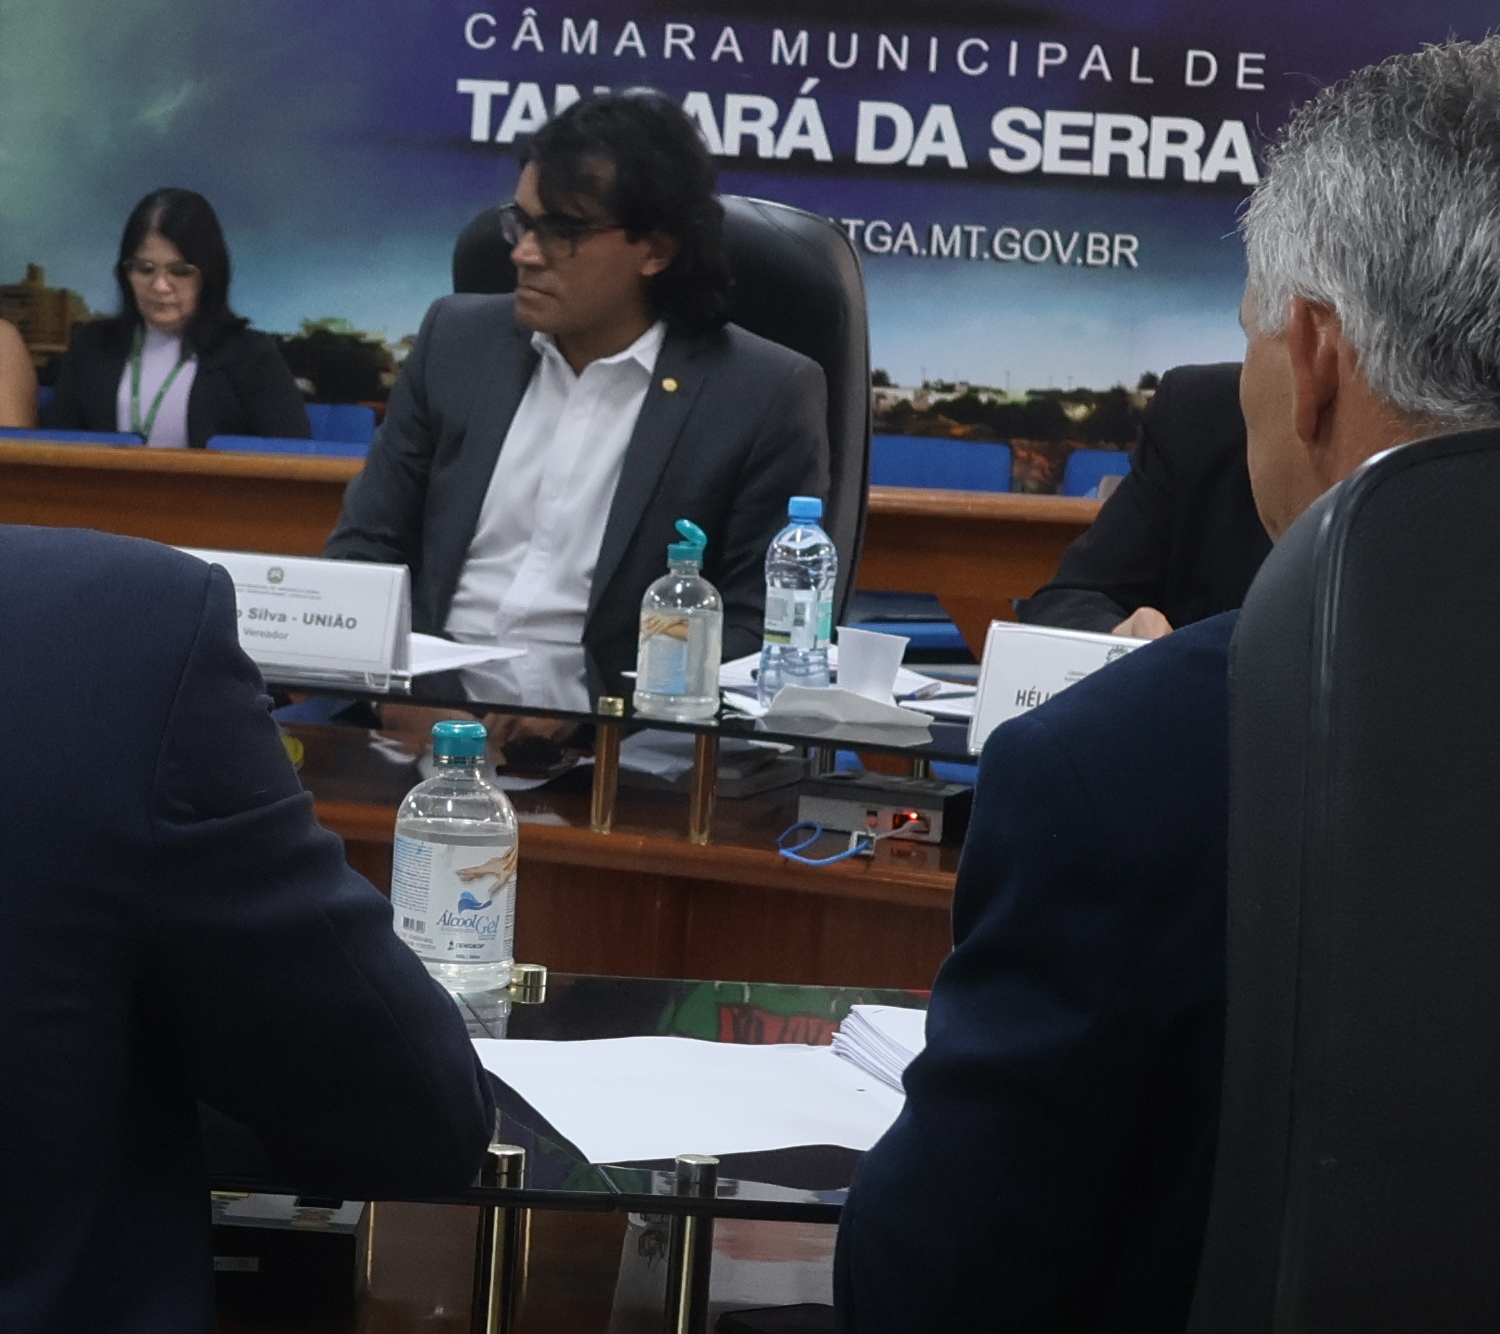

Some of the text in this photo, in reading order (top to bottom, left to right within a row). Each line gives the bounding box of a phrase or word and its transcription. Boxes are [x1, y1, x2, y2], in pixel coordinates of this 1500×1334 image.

[464, 6, 1267, 91] CÂMARA MUNICIPAL DE
[456, 77, 1260, 186] TAARÁ DA SERRA
[830, 216, 1139, 268] TGA.MT.GOV.BR
[243, 626, 290, 640] Vereador
[247, 607, 288, 623] Silva
[302, 612, 358, 631] UNIÃO
